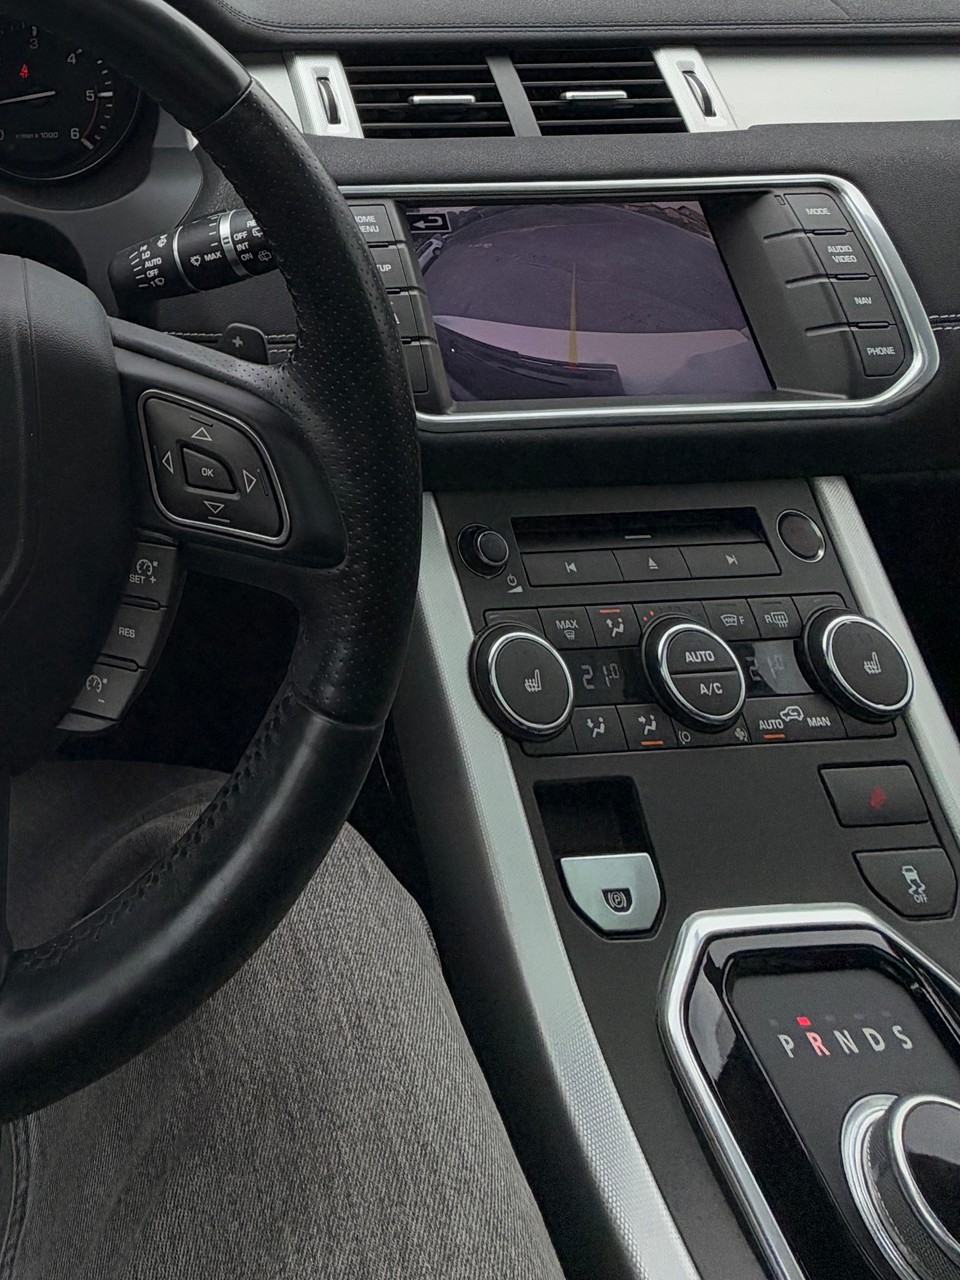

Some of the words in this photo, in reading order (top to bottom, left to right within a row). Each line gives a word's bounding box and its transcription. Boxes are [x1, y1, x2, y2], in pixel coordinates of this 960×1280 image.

[30, 38, 38, 49] 3
[66, 53, 76, 64] 4
[86, 90, 94, 101] 5
[70, 128, 80, 139] 6
[806, 208, 830, 216] MODE
[246, 219, 257, 228] RE
[233, 231, 248, 241] OFF
[236, 242, 249, 251] INT
[204, 251, 222, 262] MAX
[240, 252, 254, 261] ON
[832, 255, 857, 263] VIDEO
[144, 256, 162, 268] AUTO
[146, 268, 159, 278] OFF
[376, 264, 392, 272] TUP
[854, 296, 872, 304] NAV
[866, 346, 896, 356] PHONE
[202, 467, 214, 478] OK
[129, 574, 146, 584] SET
[556, 620, 579, 630] MAX
[118, 626, 136, 638] RES
[685, 650, 715, 663] AUTO
[699, 682, 723, 696] A/C
[759, 718, 784, 730] AUTO
[806, 716, 831, 728] MAN
[777, 1034, 795, 1058] P
[805, 1032, 831, 1056] R
[833, 1029, 860, 1054] N
[862, 1027, 886, 1052] D
[892, 1025, 913, 1049] S
